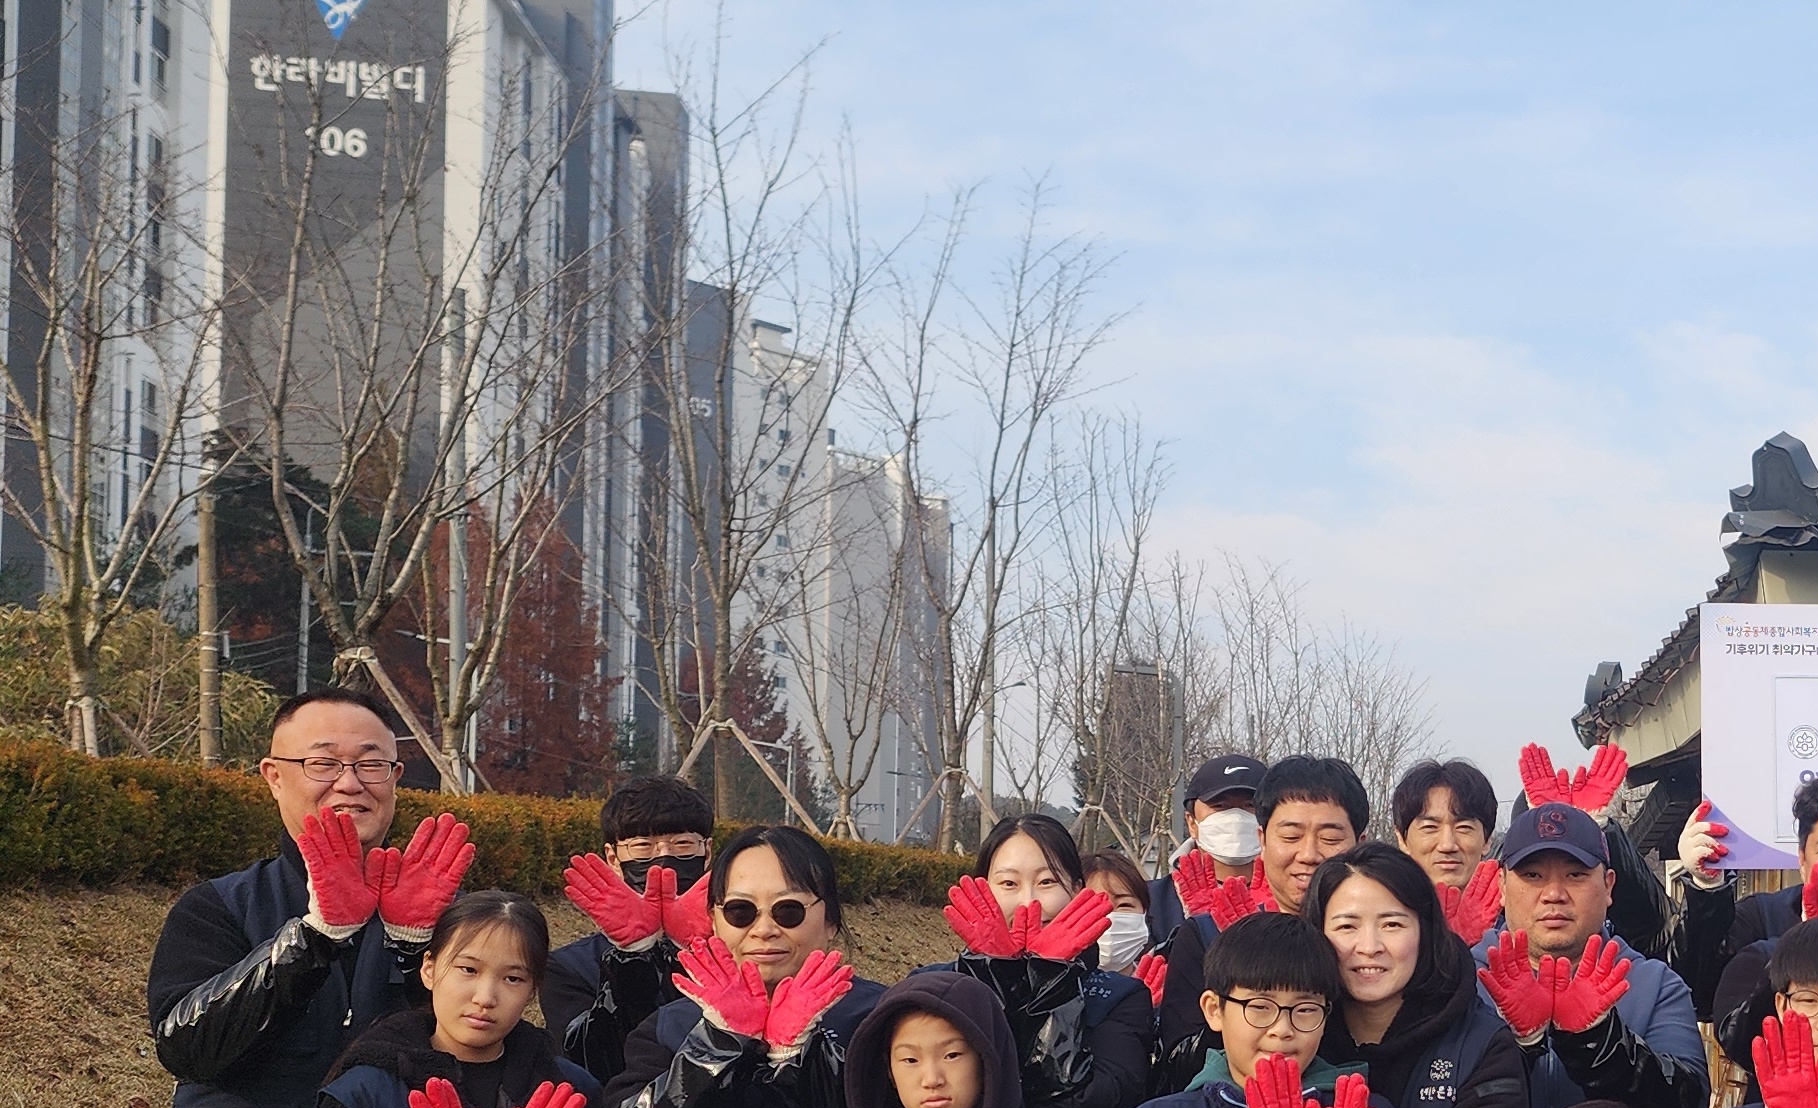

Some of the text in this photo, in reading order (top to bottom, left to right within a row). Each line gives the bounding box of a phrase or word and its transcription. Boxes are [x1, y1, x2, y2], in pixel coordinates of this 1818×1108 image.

[250, 53, 426, 103] 한라비발디
[689, 397, 712, 417] 05
[1725, 643, 1769, 656] 기후위기
